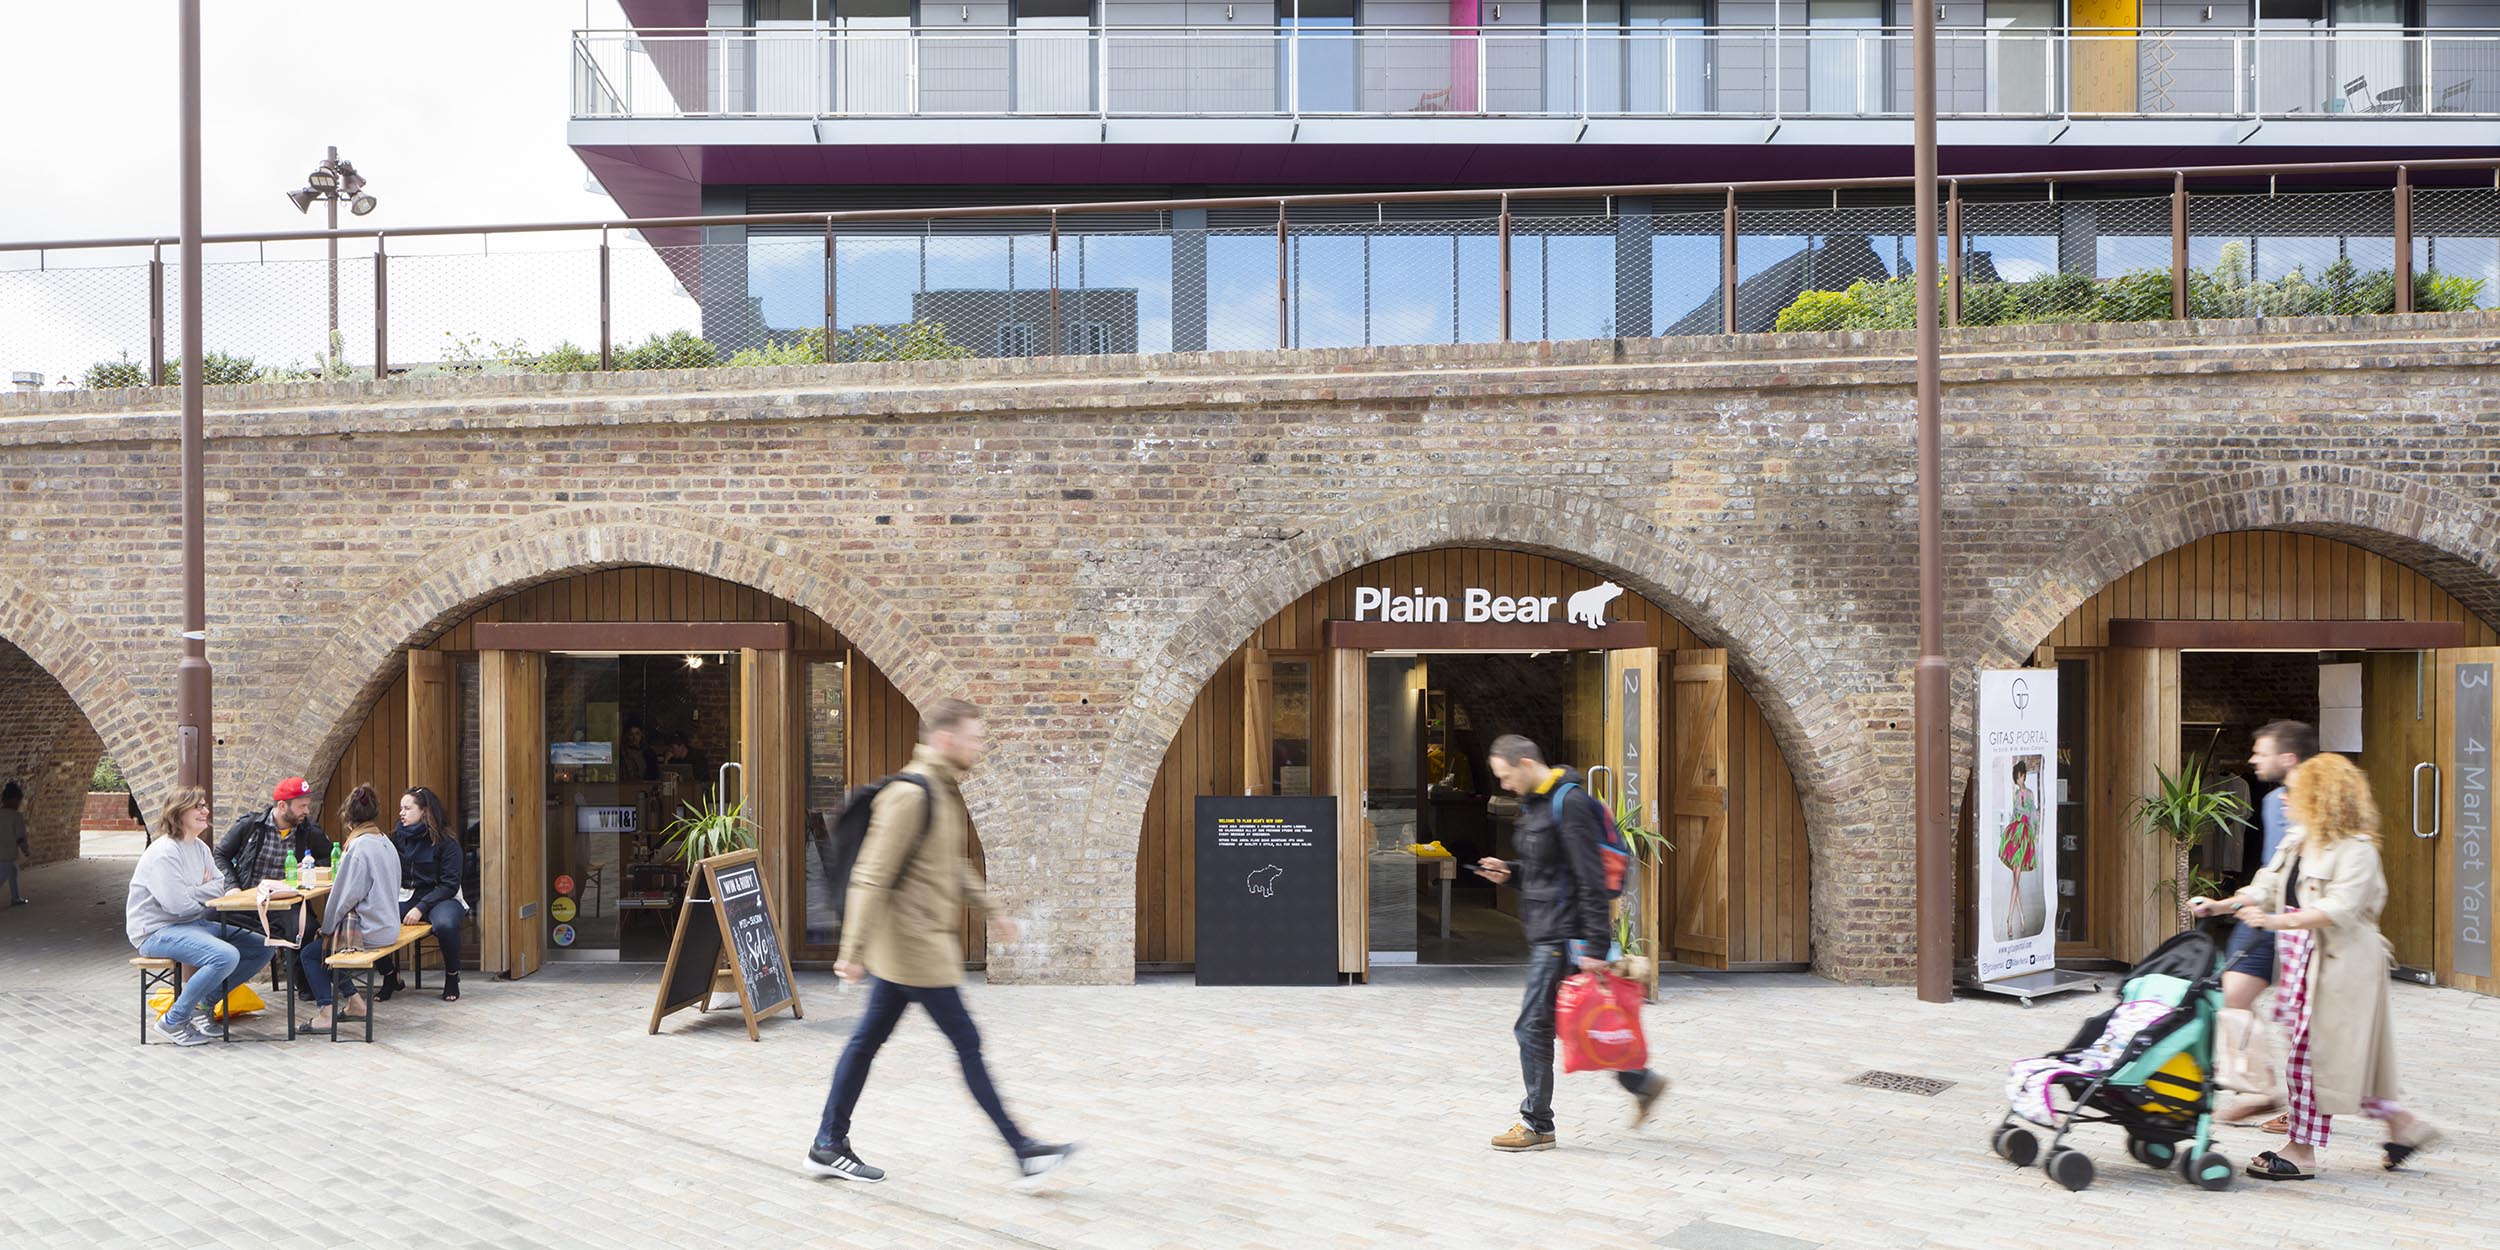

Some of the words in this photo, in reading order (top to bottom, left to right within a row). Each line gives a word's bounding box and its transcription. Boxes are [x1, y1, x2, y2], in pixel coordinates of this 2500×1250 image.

[1355, 587, 1448, 622] Plain
[1464, 588, 1557, 622] Bear
[1624, 675, 1639, 695] 2
[2460, 669, 2488, 690] 3
[1989, 731, 2014, 746] GITAS
[2016, 730, 2048, 744] PORTAL
[2463, 737, 2486, 755] 4
[1627, 742, 1639, 760] 4
[2463, 766, 2487, 870] Market
[723, 879, 737, 895] WIN
[734, 877, 742, 892] &
[739, 874, 754, 890] RUBY
[2463, 881, 2487, 945] Yard
[745, 928, 769, 972] Sale
